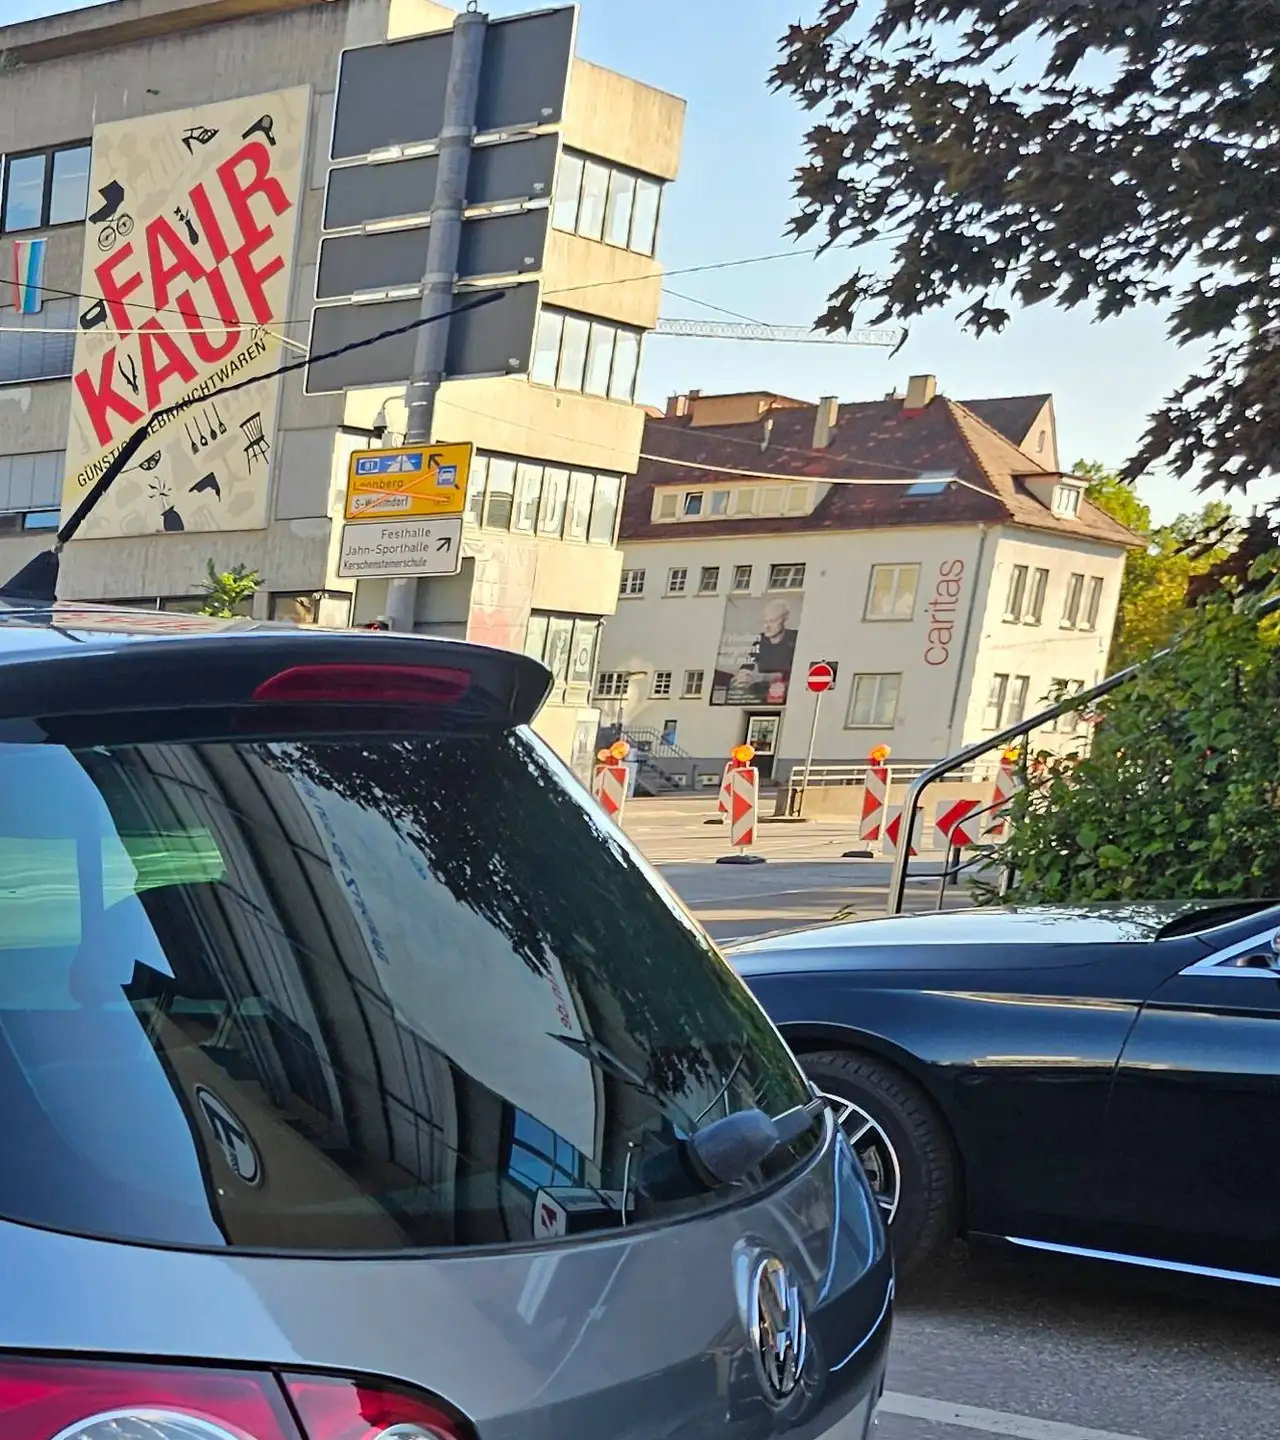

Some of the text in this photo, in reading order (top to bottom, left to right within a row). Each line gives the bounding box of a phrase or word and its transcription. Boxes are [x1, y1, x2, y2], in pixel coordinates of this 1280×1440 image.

[94, 142, 293, 340] FAIR
[74, 223, 286, 448] KAUF
[345, 543, 430, 556] Jahn-Sporthalle
[381, 528, 431, 540] Festhalle
[924, 559, 964, 666] caritas
